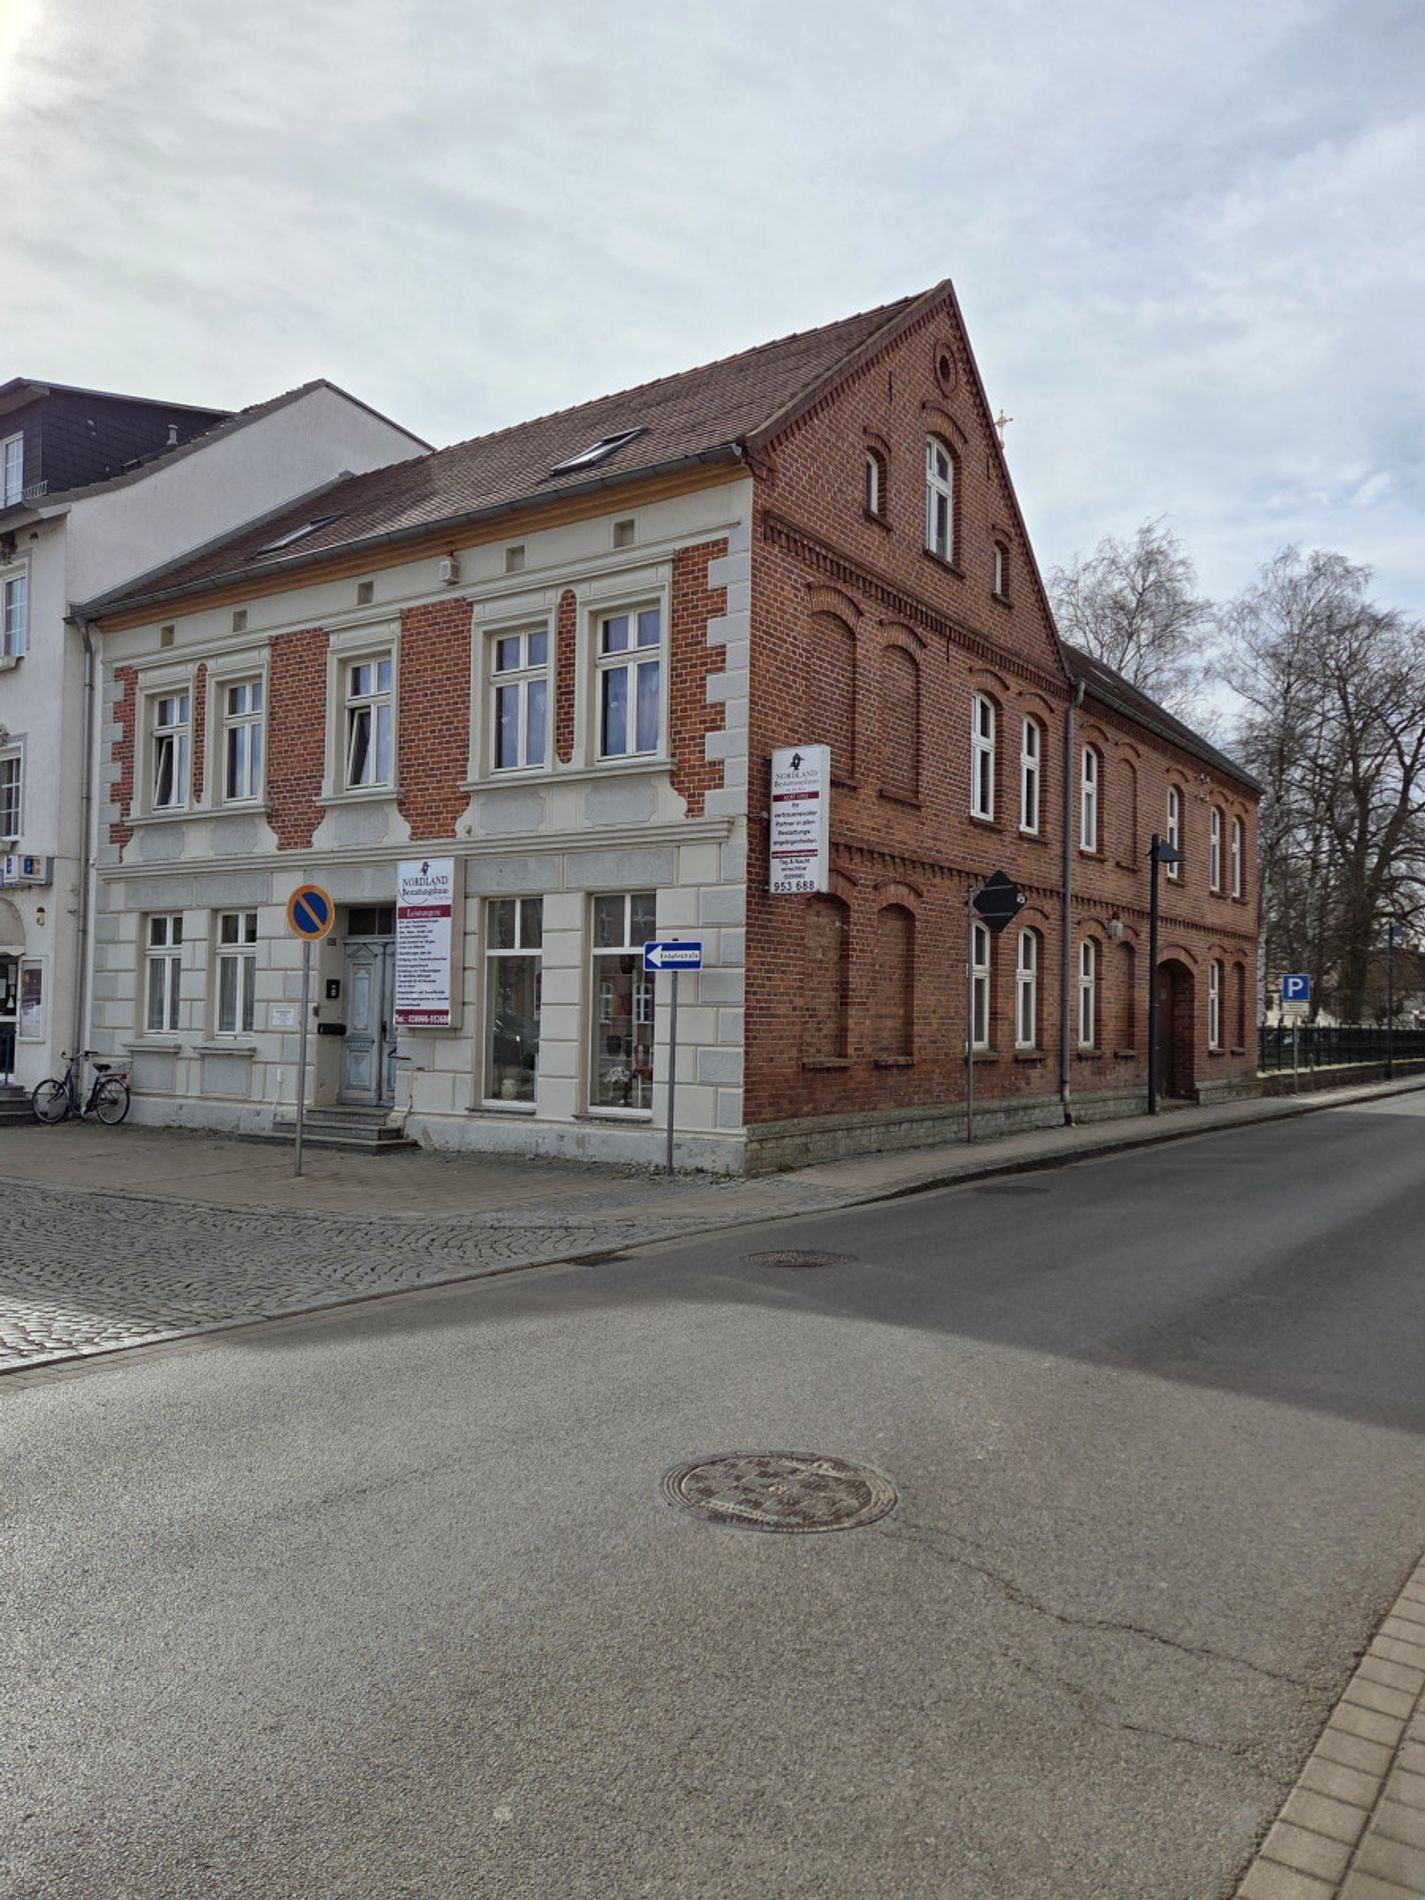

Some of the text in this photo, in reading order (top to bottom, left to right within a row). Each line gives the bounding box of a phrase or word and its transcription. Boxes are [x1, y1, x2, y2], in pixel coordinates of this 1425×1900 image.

[776, 770, 818, 779] NORDLAND
[402, 875, 448, 887] NORDLAND
[774, 880, 815, 892] 953 688
[402, 887, 449, 898] Bestattungshaus
[1288, 977, 1304, 997] P
